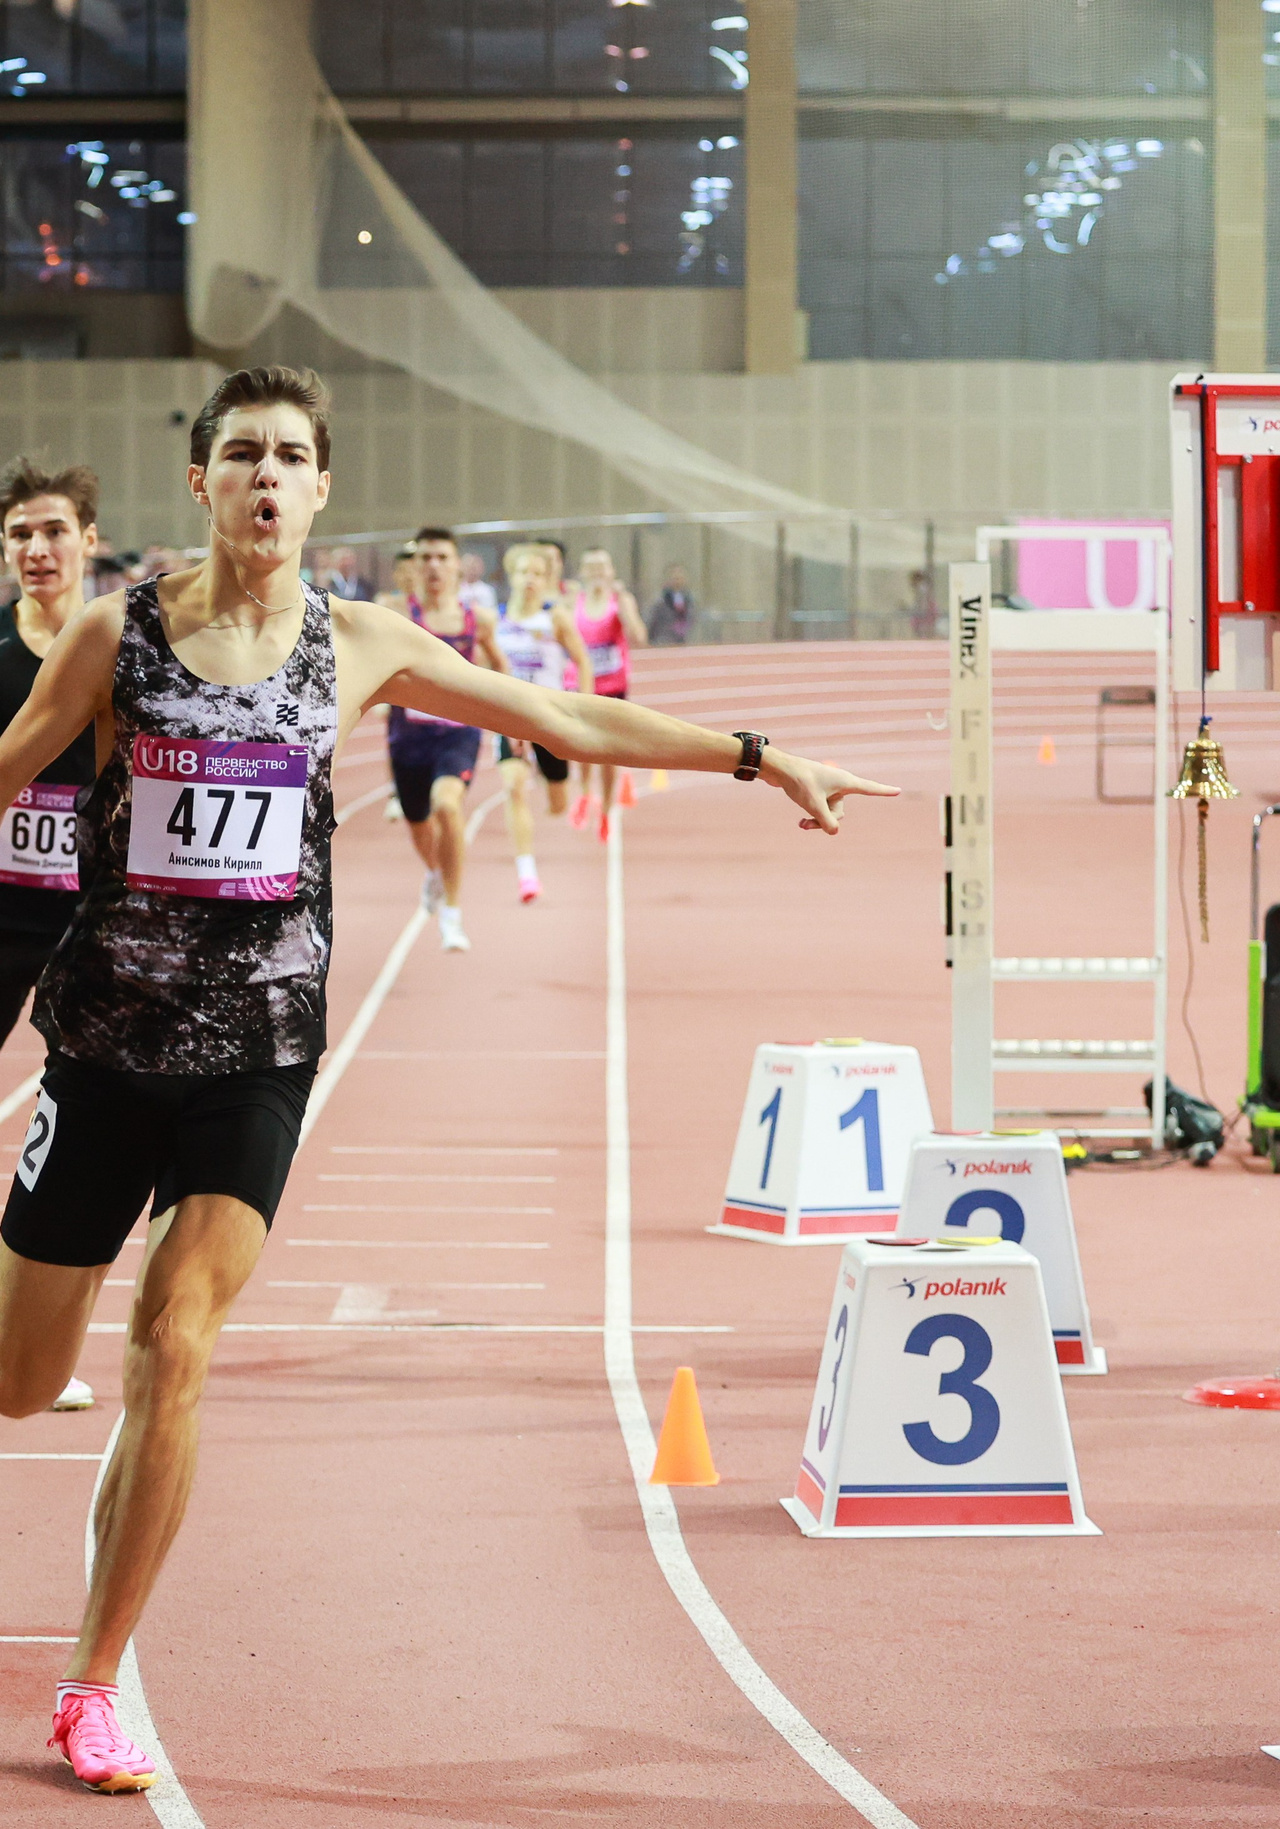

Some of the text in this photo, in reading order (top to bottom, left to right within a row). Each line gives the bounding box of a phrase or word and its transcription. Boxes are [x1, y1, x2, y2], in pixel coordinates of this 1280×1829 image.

[142, 746, 198, 774] U18
[205, 766, 258, 778] РОССИИ
[206, 757, 288, 770] ПЕРВЕНСТВО
[11, 811, 78, 856] 603
[167, 787, 272, 850] 477
[168, 852, 263, 873] Анисимов Кирилл
[22, 1111, 50, 1174] 2
[759, 1086, 783, 1190] 1
[839, 1088, 884, 1192] 1
[963, 1159, 1034, 1178] polanik
[923, 1276, 1008, 1301] polanik
[902, 1313, 1001, 1466] 3
